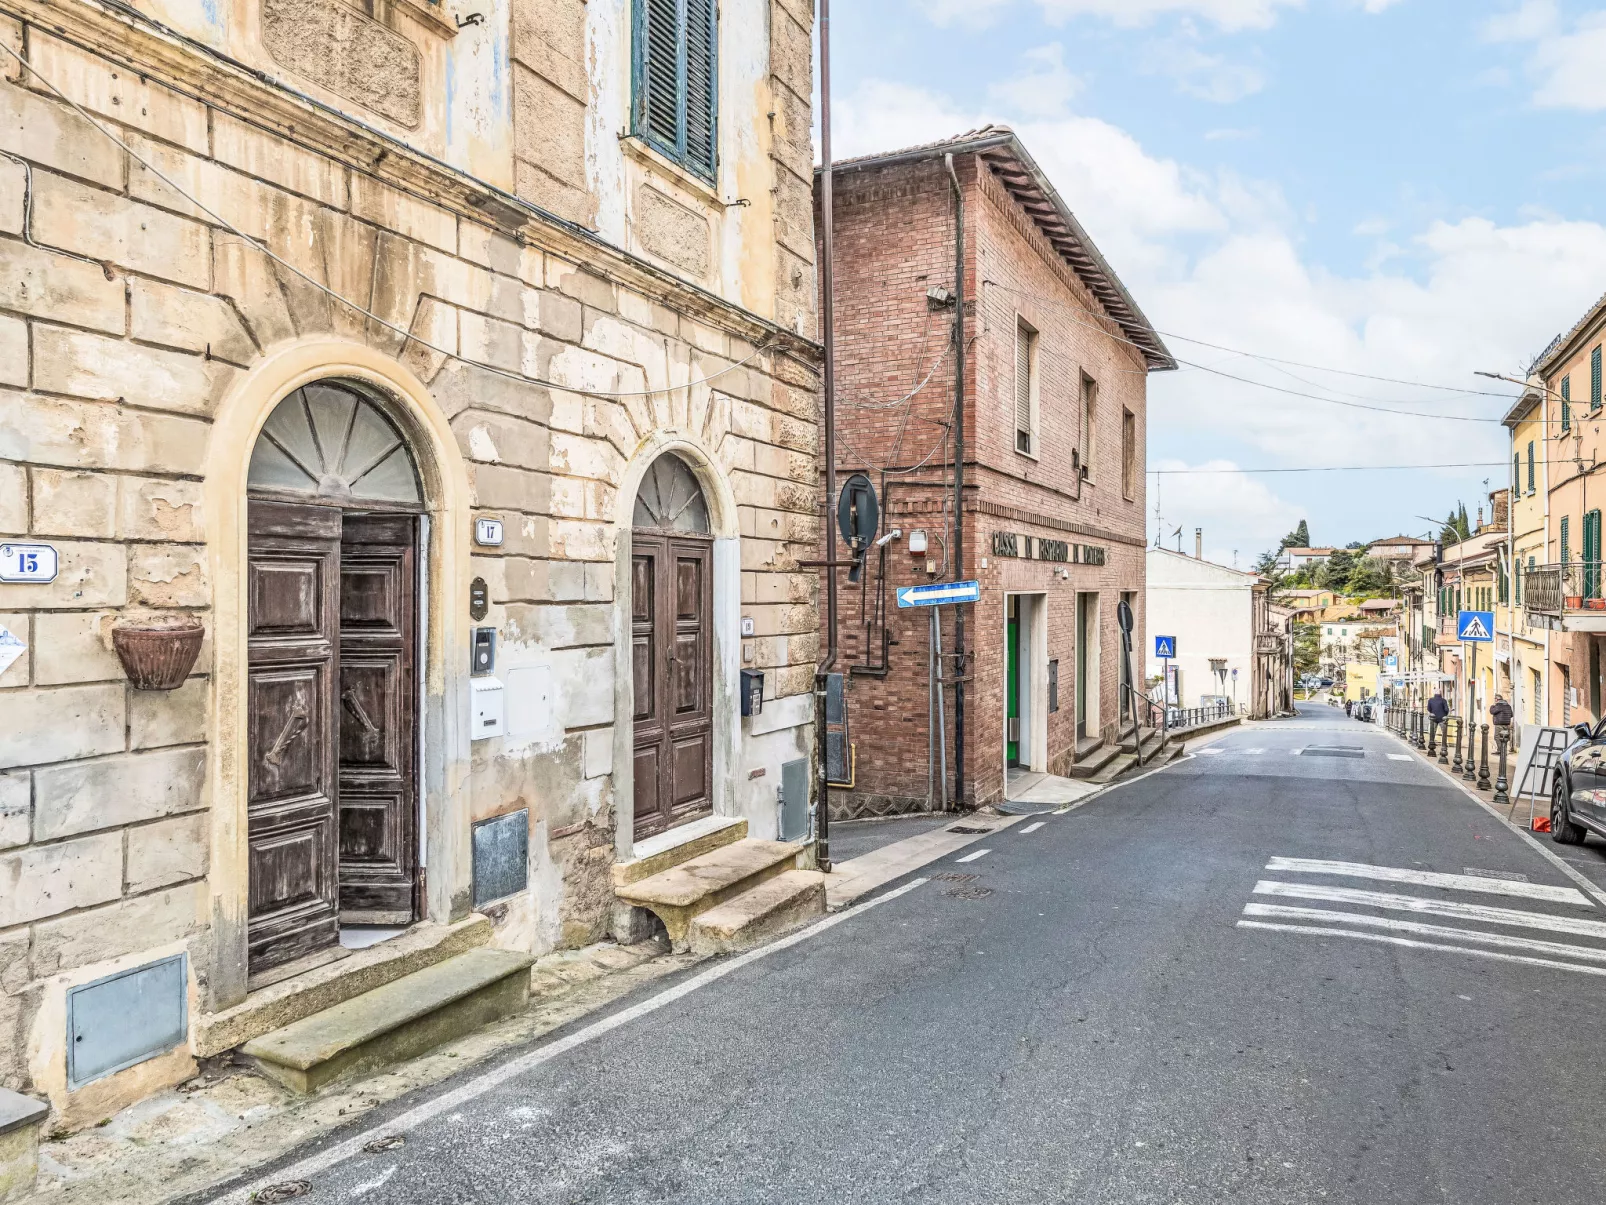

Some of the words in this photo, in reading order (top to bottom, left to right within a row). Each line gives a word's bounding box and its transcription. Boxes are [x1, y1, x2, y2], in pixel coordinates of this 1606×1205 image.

[486, 525, 495, 539] 17
[992, 529, 1018, 558] CASSA
[18, 553, 39, 573] 15
